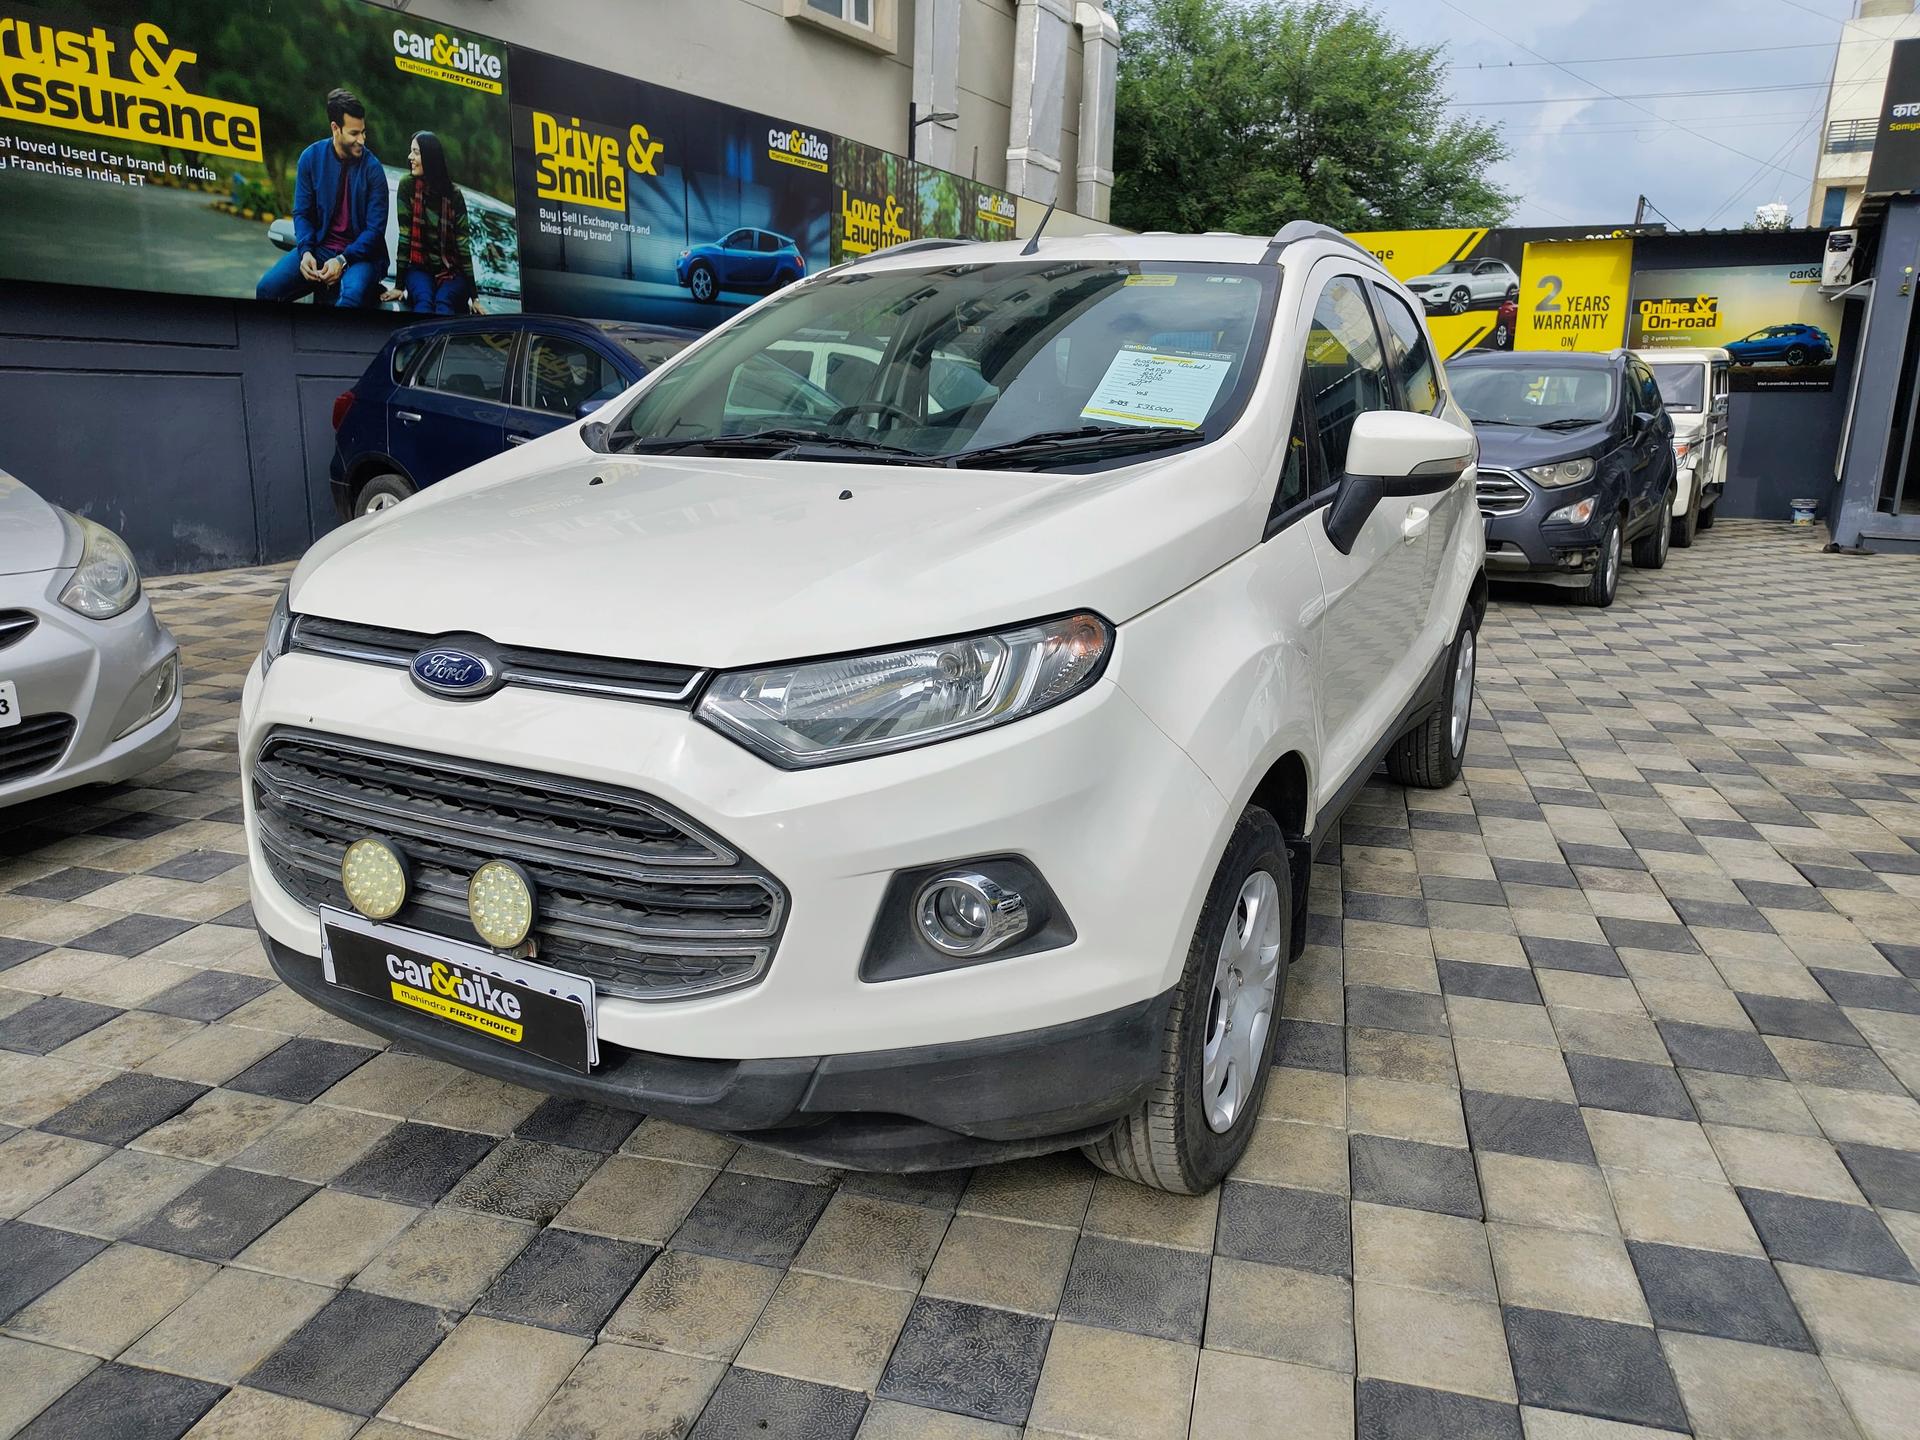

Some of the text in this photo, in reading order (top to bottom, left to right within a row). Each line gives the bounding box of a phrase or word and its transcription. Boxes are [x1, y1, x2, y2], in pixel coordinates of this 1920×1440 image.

[130, 22, 197, 93] &
[393, 29, 501, 79] car&bike
[441, 71, 465, 83] FIRST
[465, 78, 494, 90] CHOICE
[533, 111, 665, 176] Drive &
[768, 129, 829, 161] car&bike
[10, 155, 83, 179] Franchise
[86, 166, 126, 187] India,
[128, 173, 146, 188] ET
[16, 139, 57, 156] loved
[60, 145, 98, 163] Used
[100, 151, 123, 167] Car
[126, 155, 166, 173] brand
[169, 162, 183, 176] of
[185, 164, 217, 182] India
[536, 152, 622, 204] Smile
[540, 208, 557, 223] Buy
[561, 212, 578, 224] Sell
[583, 215, 620, 231] Exchange
[620, 223, 636, 233] cars
[636, 225, 651, 235] and
[842, 190, 904, 229] Love &
[540, 222, 613, 242] bikes of any brand
[1535, 275, 1611, 312] 2 YEARS
[1640, 294, 1719, 315] Online &
[1533, 313, 1609, 330] WARRANTY
[1648, 313, 1717, 329] On-road
[424, 654, 472, 682] Ford
[385, 954, 522, 1020] car&bike
[449, 1006, 479, 1022] FIRST
[480, 1017, 518, 1036] CHOICE
